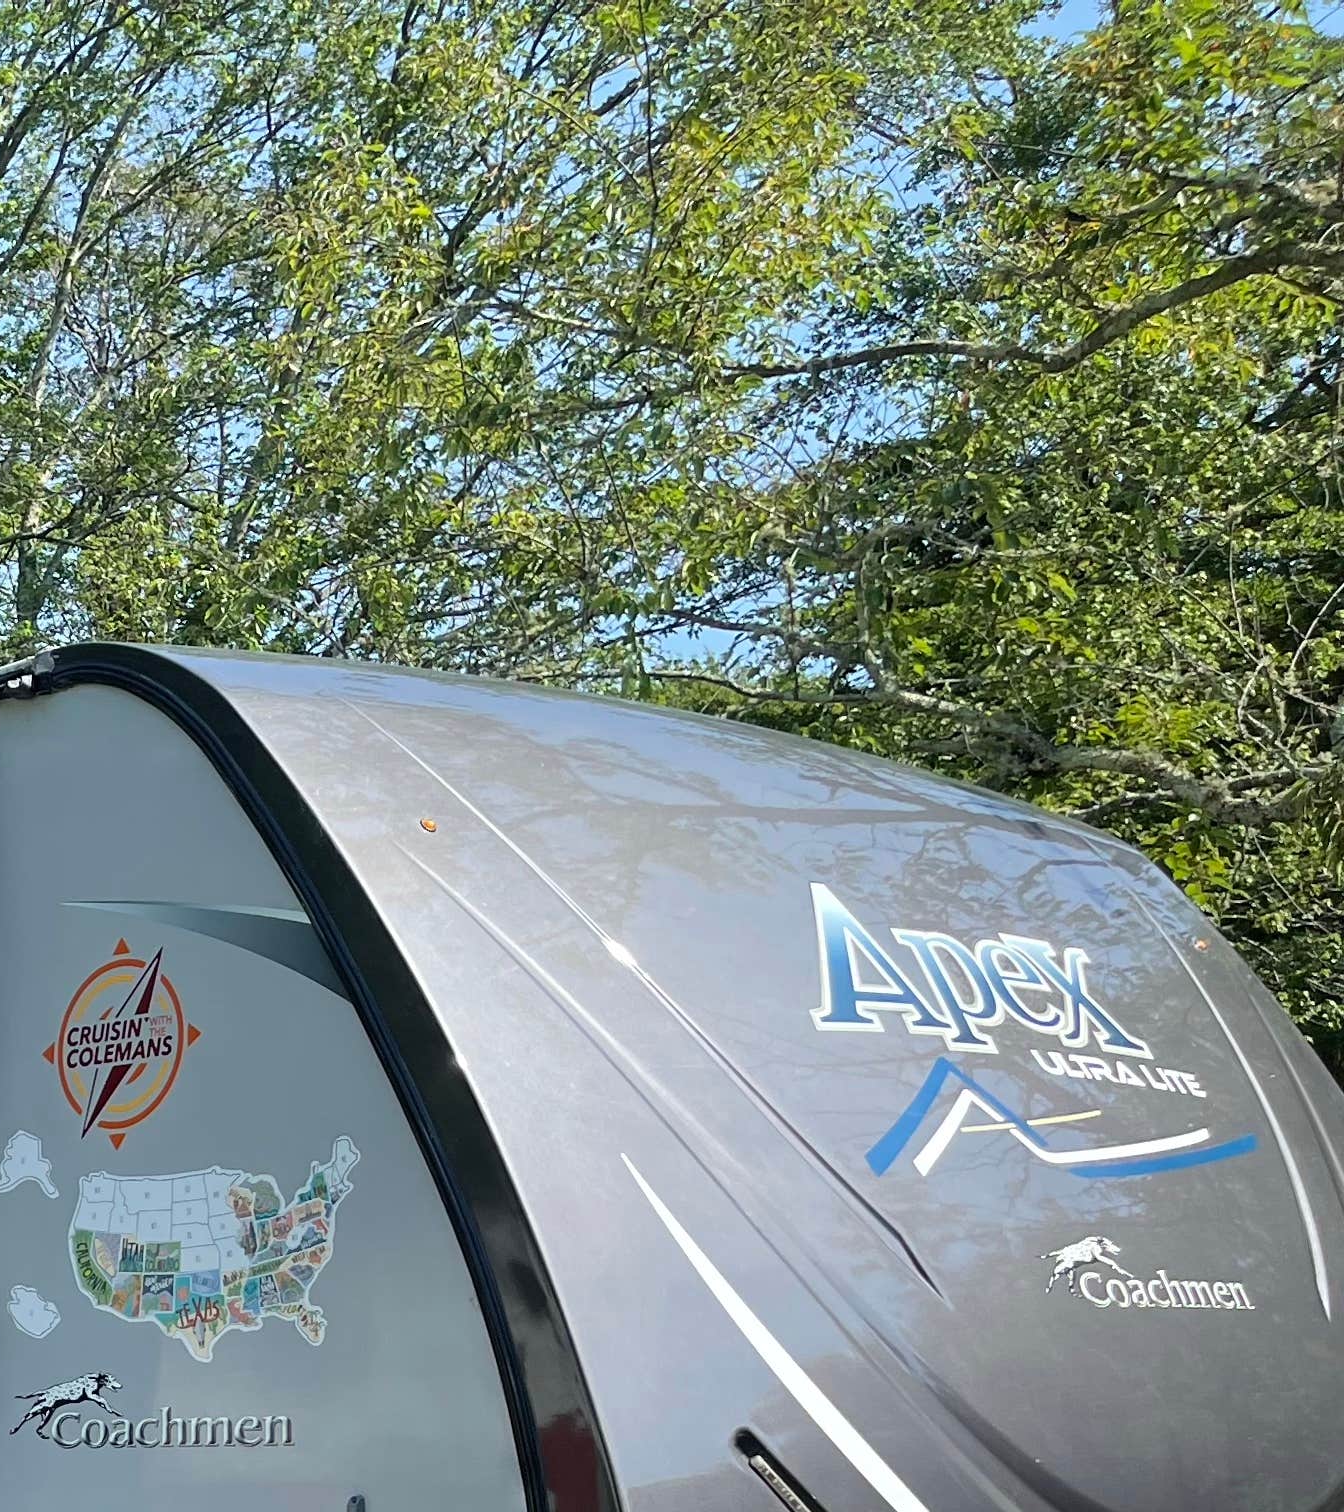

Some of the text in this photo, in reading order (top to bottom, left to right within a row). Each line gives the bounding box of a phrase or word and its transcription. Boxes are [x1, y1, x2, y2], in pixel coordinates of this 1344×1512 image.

[809, 882, 1153, 1059] Apex
[149, 1016, 173, 1026] WITH
[150, 1027, 166, 1037] THE
[66, 1036, 173, 1069] COLEMANS
[1030, 1049, 1207, 1098] ULTRA LITE
[76, 1242, 107, 1294] CALIFORNIA
[1079, 1270, 1256, 1310] Coachmen
[176, 1297, 221, 1329] TEXAS
[52, 1406, 295, 1450] Coachmen
